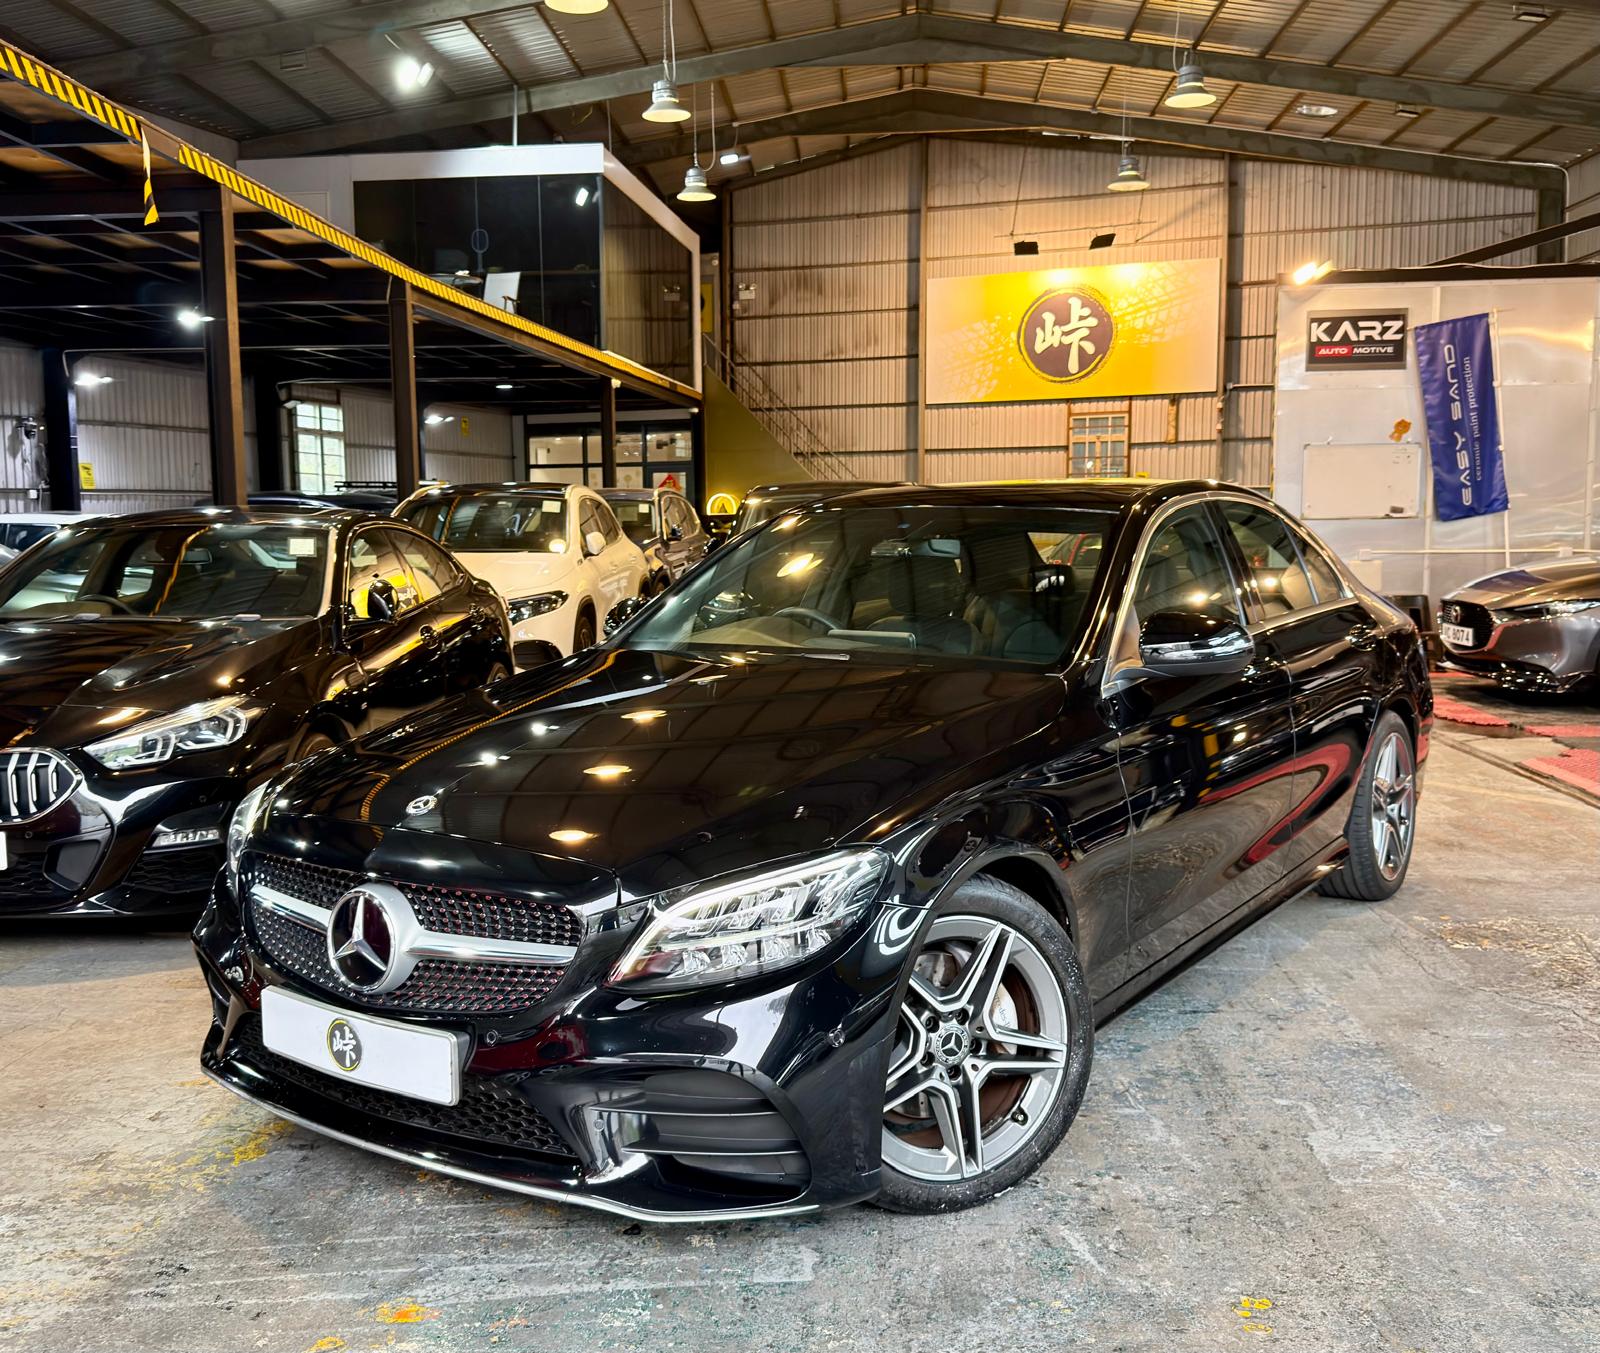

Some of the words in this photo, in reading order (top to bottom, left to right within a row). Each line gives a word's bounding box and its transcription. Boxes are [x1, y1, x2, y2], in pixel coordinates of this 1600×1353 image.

[1034, 297, 1098, 374] 峠
[1310, 320, 1403, 342] KARZ
[1318, 347, 1349, 355] AUTO
[1352, 346, 1394, 354] MOTIVE
[1444, 344, 1462, 421] SAND
[1463, 356, 1479, 409] protection
[1469, 412, 1481, 438] paint
[1453, 431, 1473, 506] EASY
[1473, 441, 1482, 481] ceramic
[332, 1025, 357, 1068] 峠
